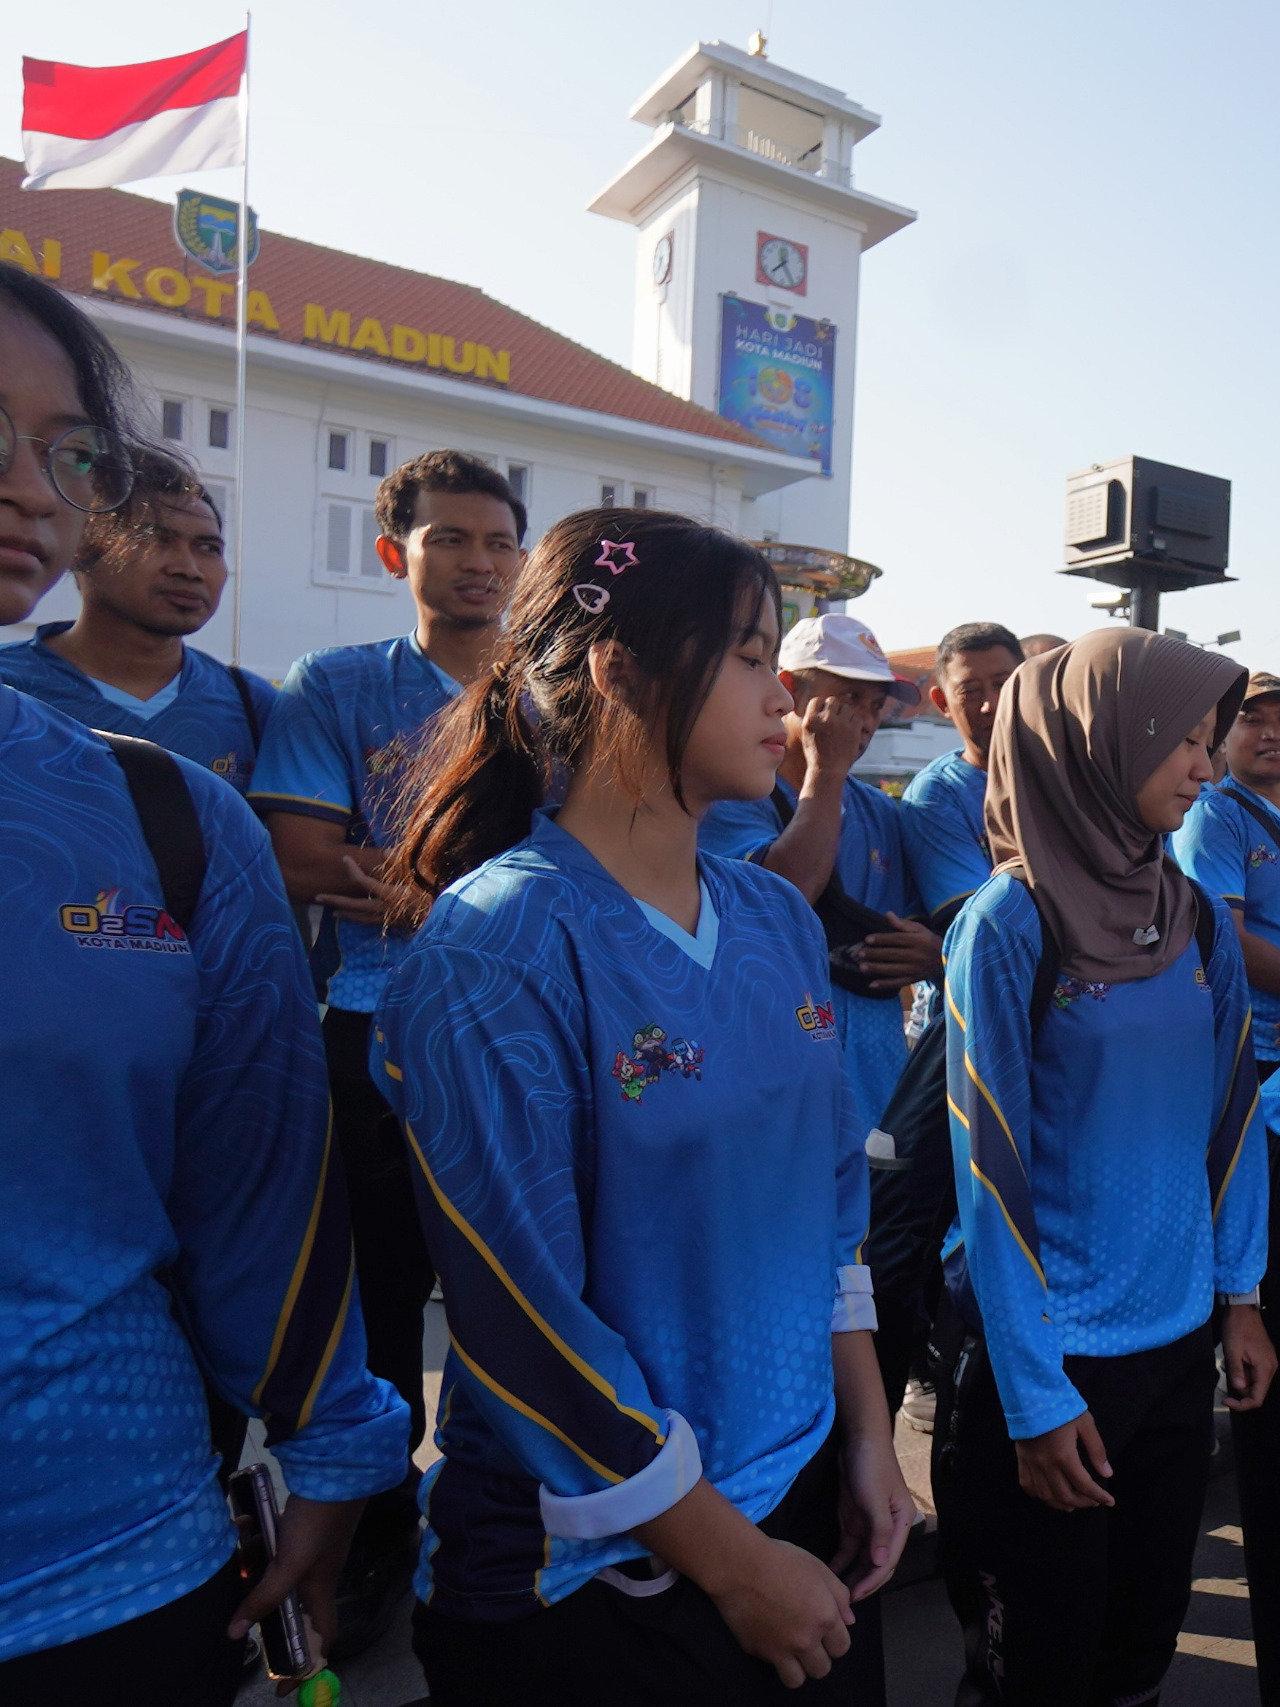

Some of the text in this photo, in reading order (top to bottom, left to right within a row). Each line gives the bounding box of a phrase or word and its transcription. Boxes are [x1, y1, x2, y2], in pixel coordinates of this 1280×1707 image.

[92, 250, 280, 333] KOTA
[304, 303, 511, 384] MADIUN
[735, 339, 769, 356] KOTA
[77, 936, 190, 953] KOTA MADIUN
